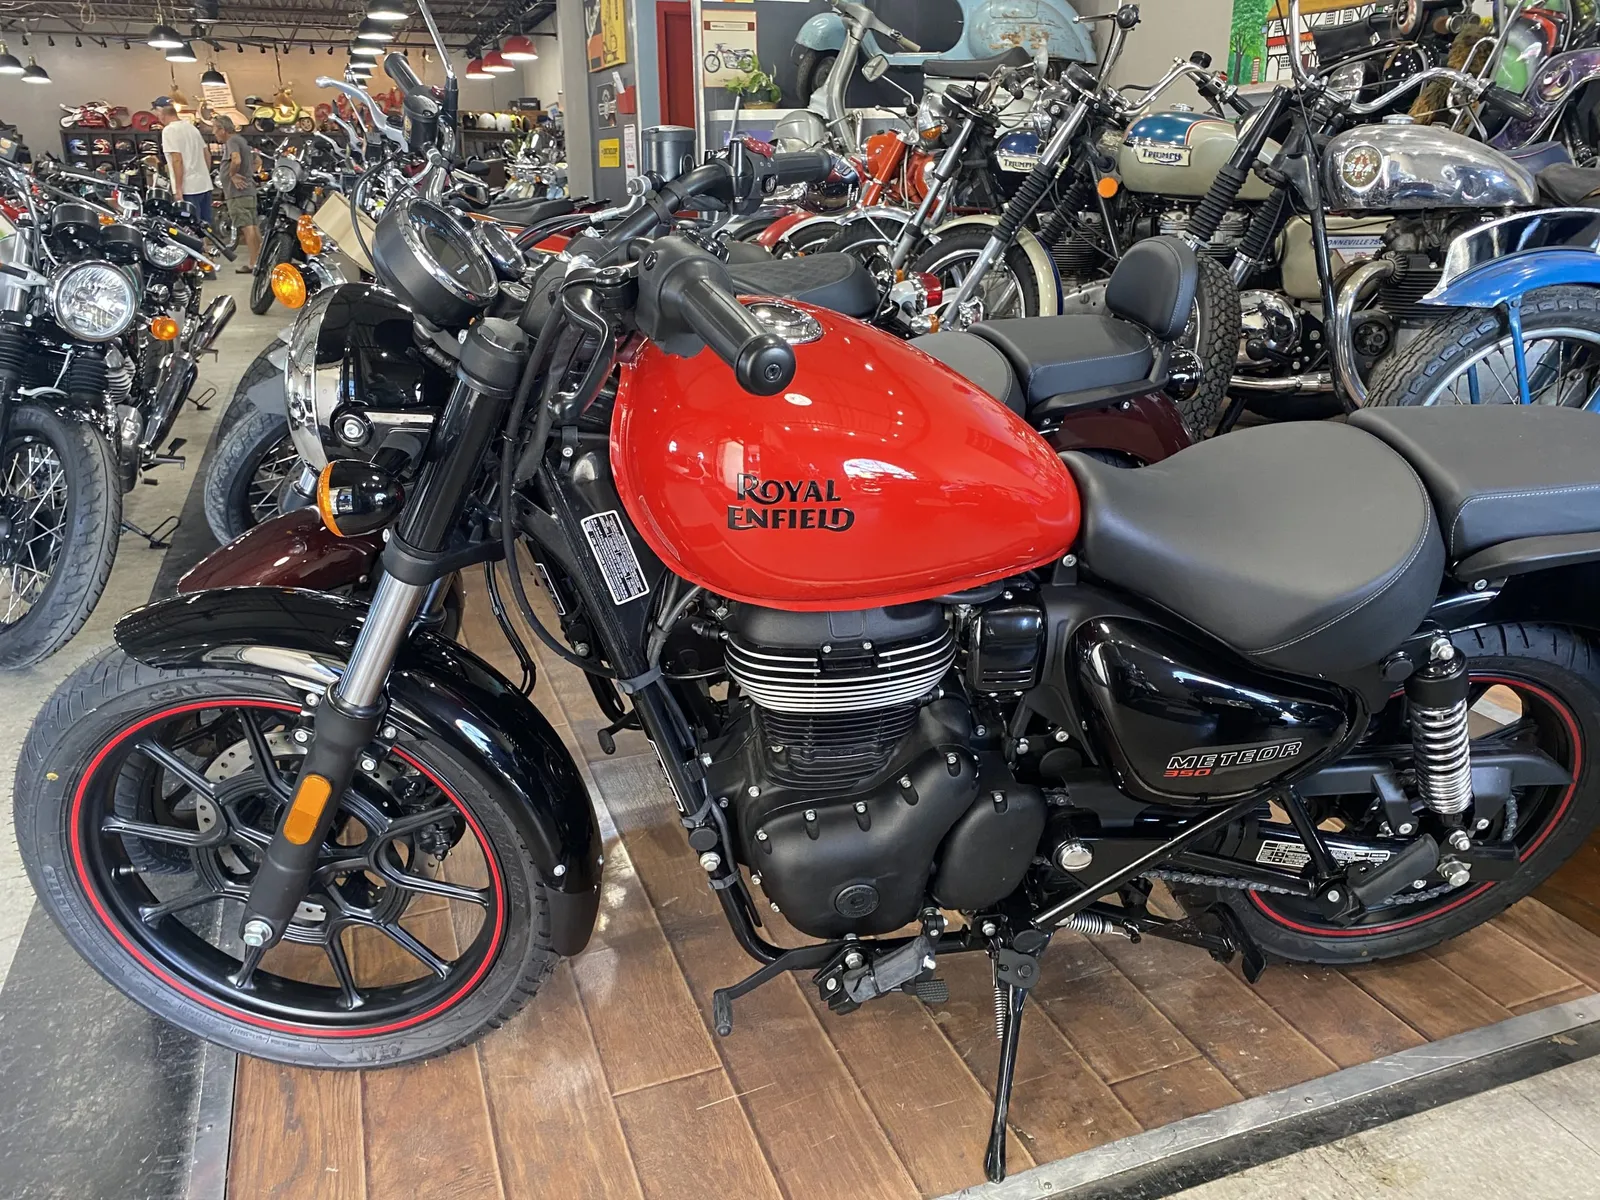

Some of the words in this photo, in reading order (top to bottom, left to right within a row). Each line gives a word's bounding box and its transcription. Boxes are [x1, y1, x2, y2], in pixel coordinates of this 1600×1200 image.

[1142, 148, 1183, 163] TRIUMPH
[736, 473, 842, 505] ROYAL
[727, 504, 855, 532] ENFIELD
[1166, 741, 1303, 769] METEOR
[1163, 768, 1212, 778] 350
